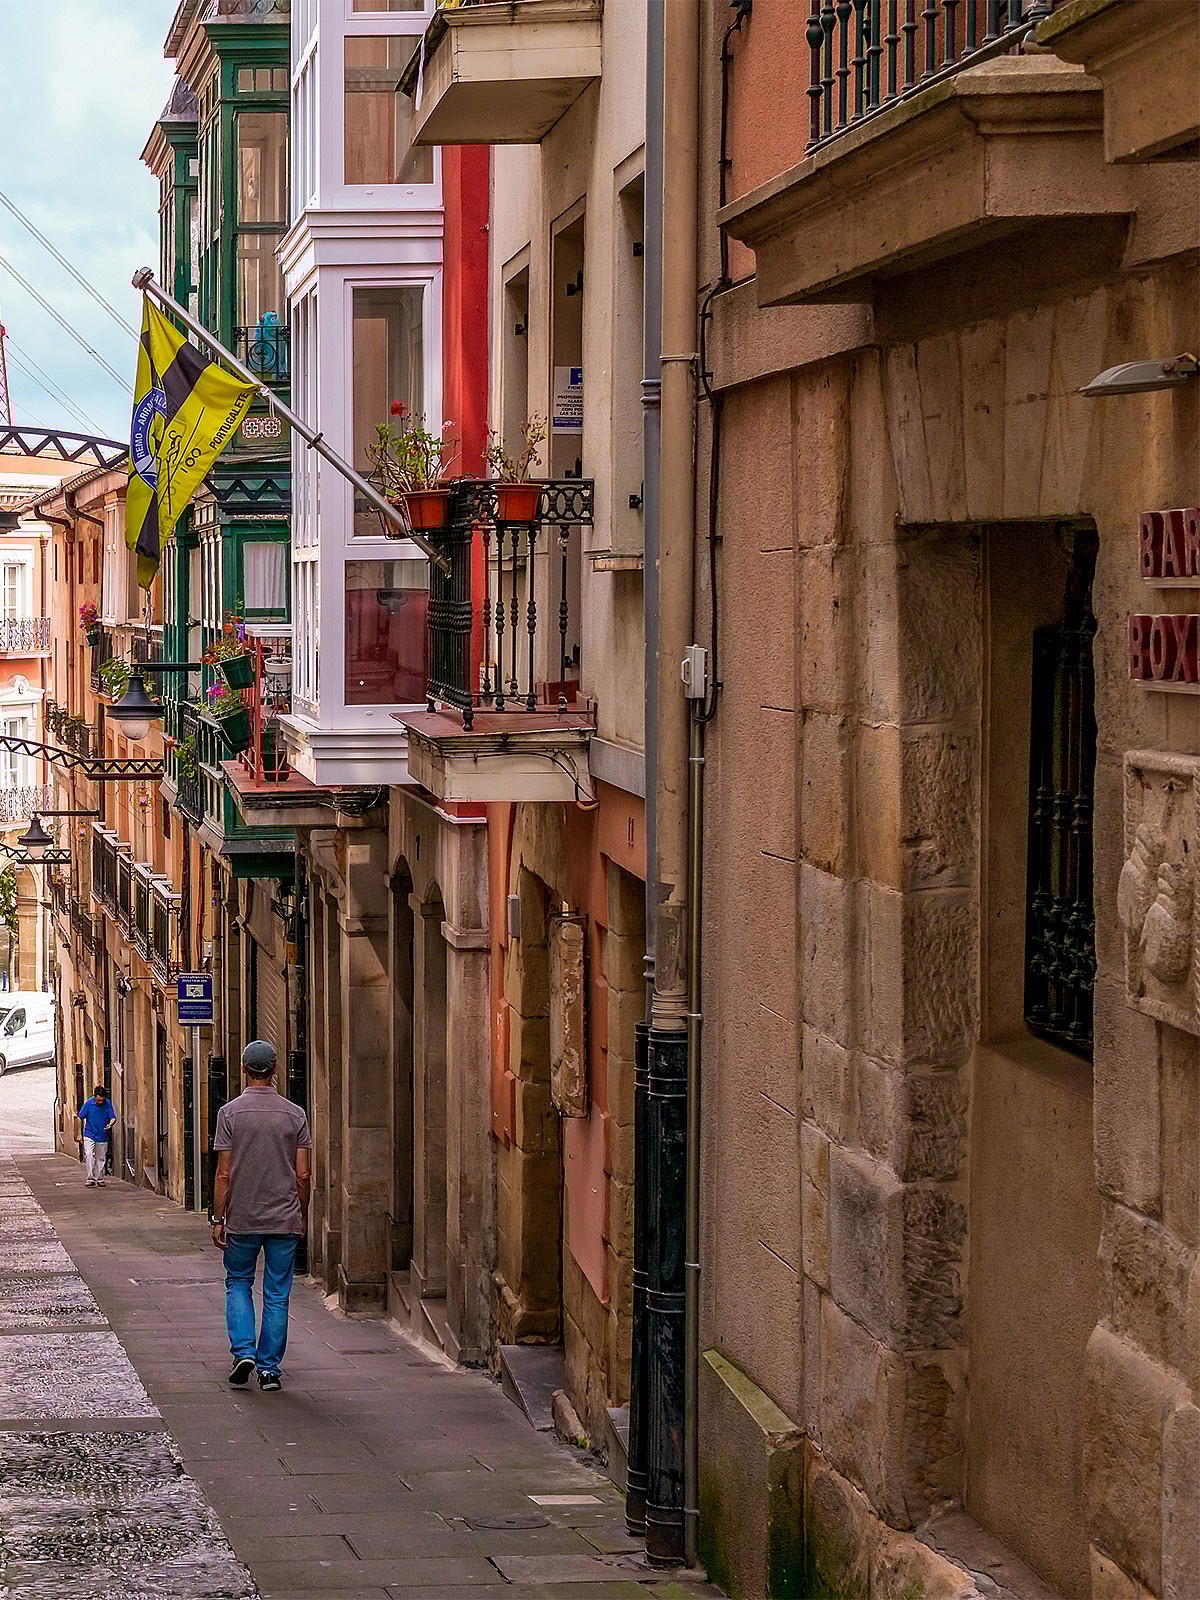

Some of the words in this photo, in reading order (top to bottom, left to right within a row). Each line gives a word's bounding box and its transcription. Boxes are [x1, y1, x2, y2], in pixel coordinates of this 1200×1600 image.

[135, 433, 145, 459] REMO
[209, 392, 249, 450] PORTUGALETE
[180, 447, 202, 474] 100
[1139, 508, 1200, 578] BAR
[1128, 614, 1200, 683] BOX
